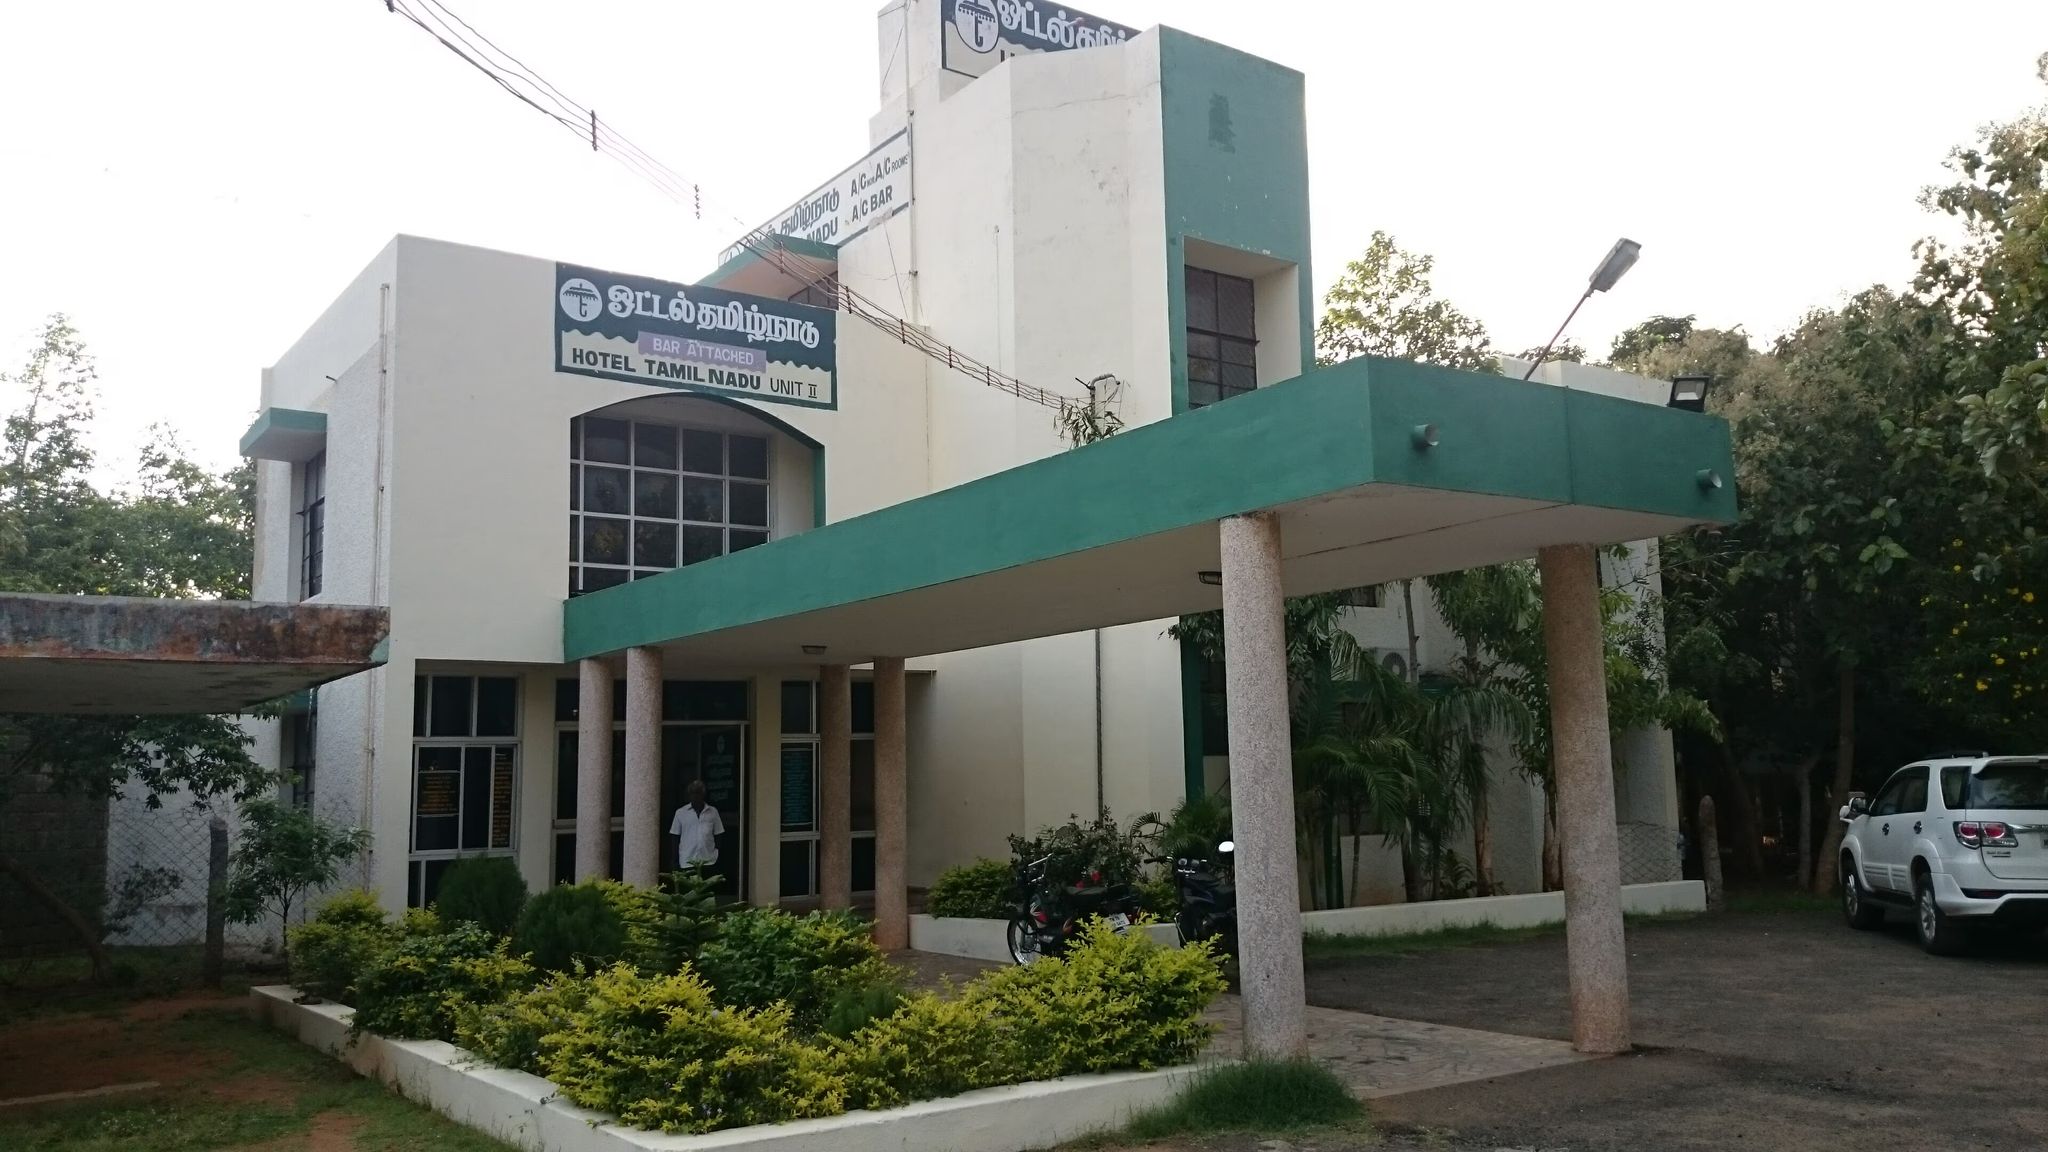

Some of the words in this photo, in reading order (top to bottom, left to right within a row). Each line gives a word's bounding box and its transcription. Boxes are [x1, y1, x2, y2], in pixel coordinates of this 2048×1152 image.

[852, 198, 868, 222] A/C
[871, 185, 892, 212] BAR
[697, 301, 819, 348] தமிழ்நாடு
[653, 337, 680, 355] BAR
[687, 342, 754, 365] ATTACHED
[572, 347, 636, 372] HOTEL
[644, 358, 708, 383] TAMIL
[708, 369, 761, 390] NADU
[770, 378, 803, 397] UNIT
[808, 384, 818, 399] II
